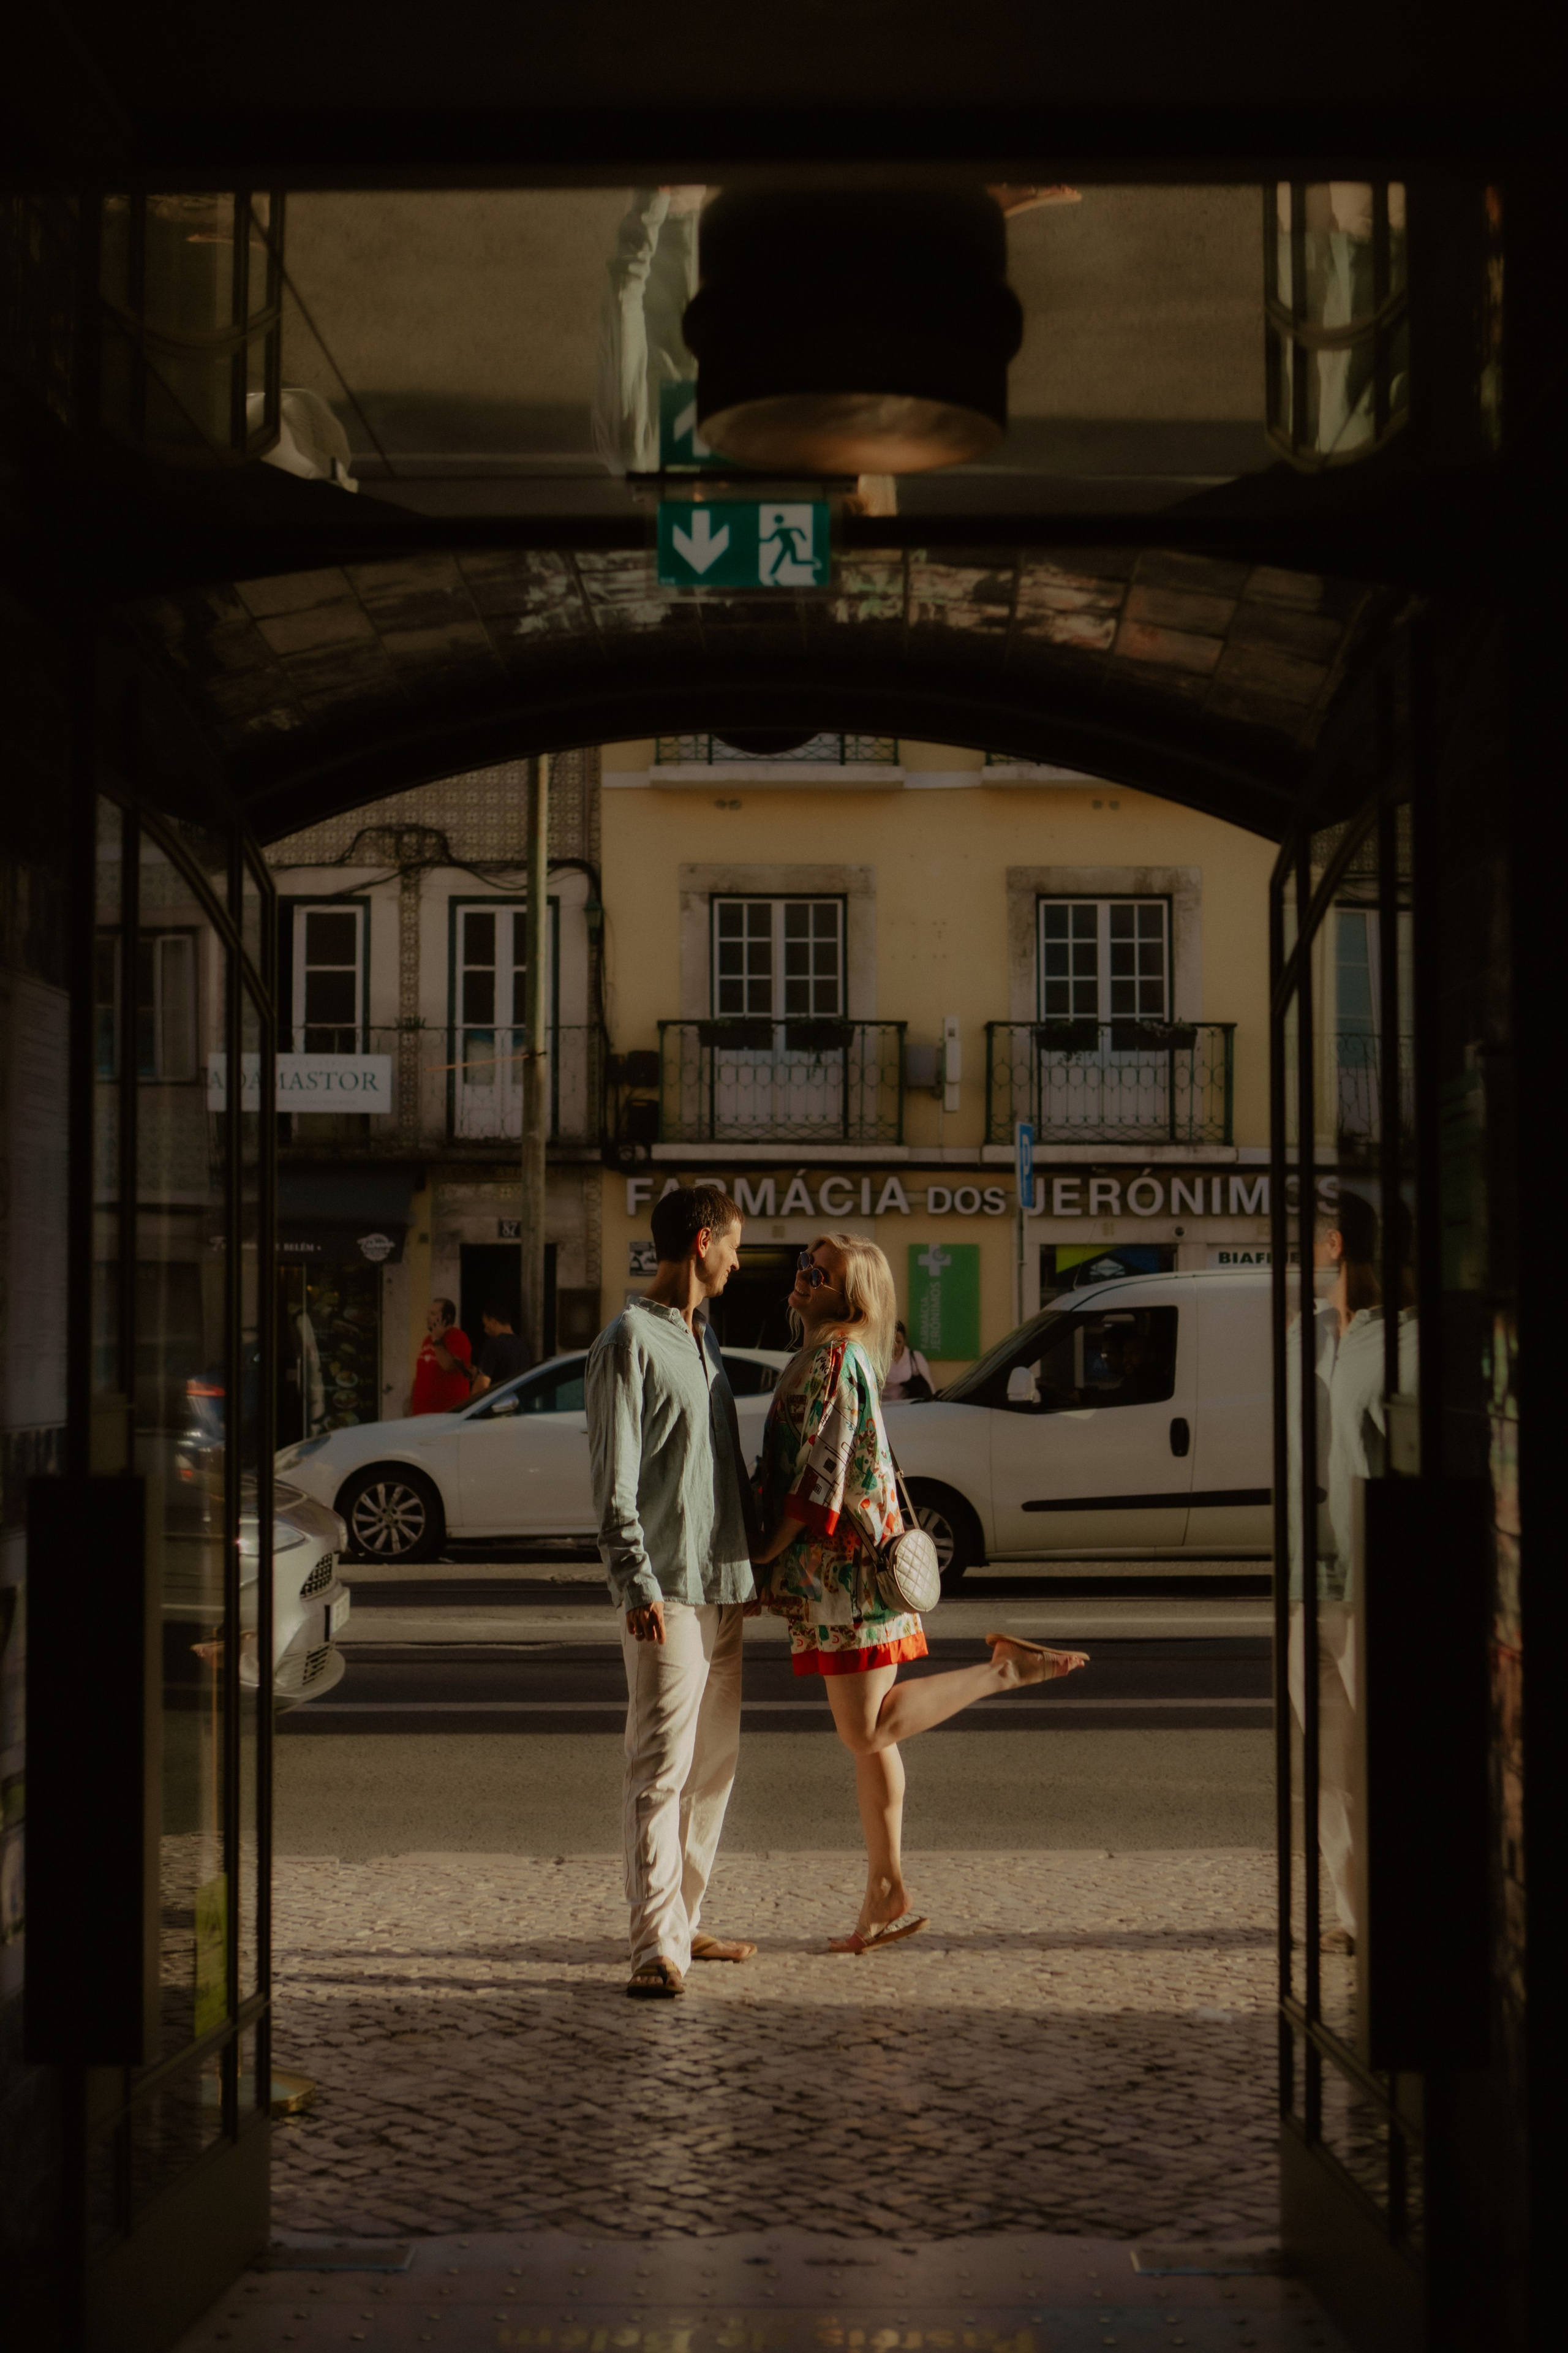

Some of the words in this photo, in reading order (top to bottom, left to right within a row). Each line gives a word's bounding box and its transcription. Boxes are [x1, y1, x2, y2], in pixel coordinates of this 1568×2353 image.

[927, 1186, 1006, 1215] DOS
[919, 1296, 929, 1350] FARMÁCIA
[929, 1282, 941, 1351] JERÓNIMOS
